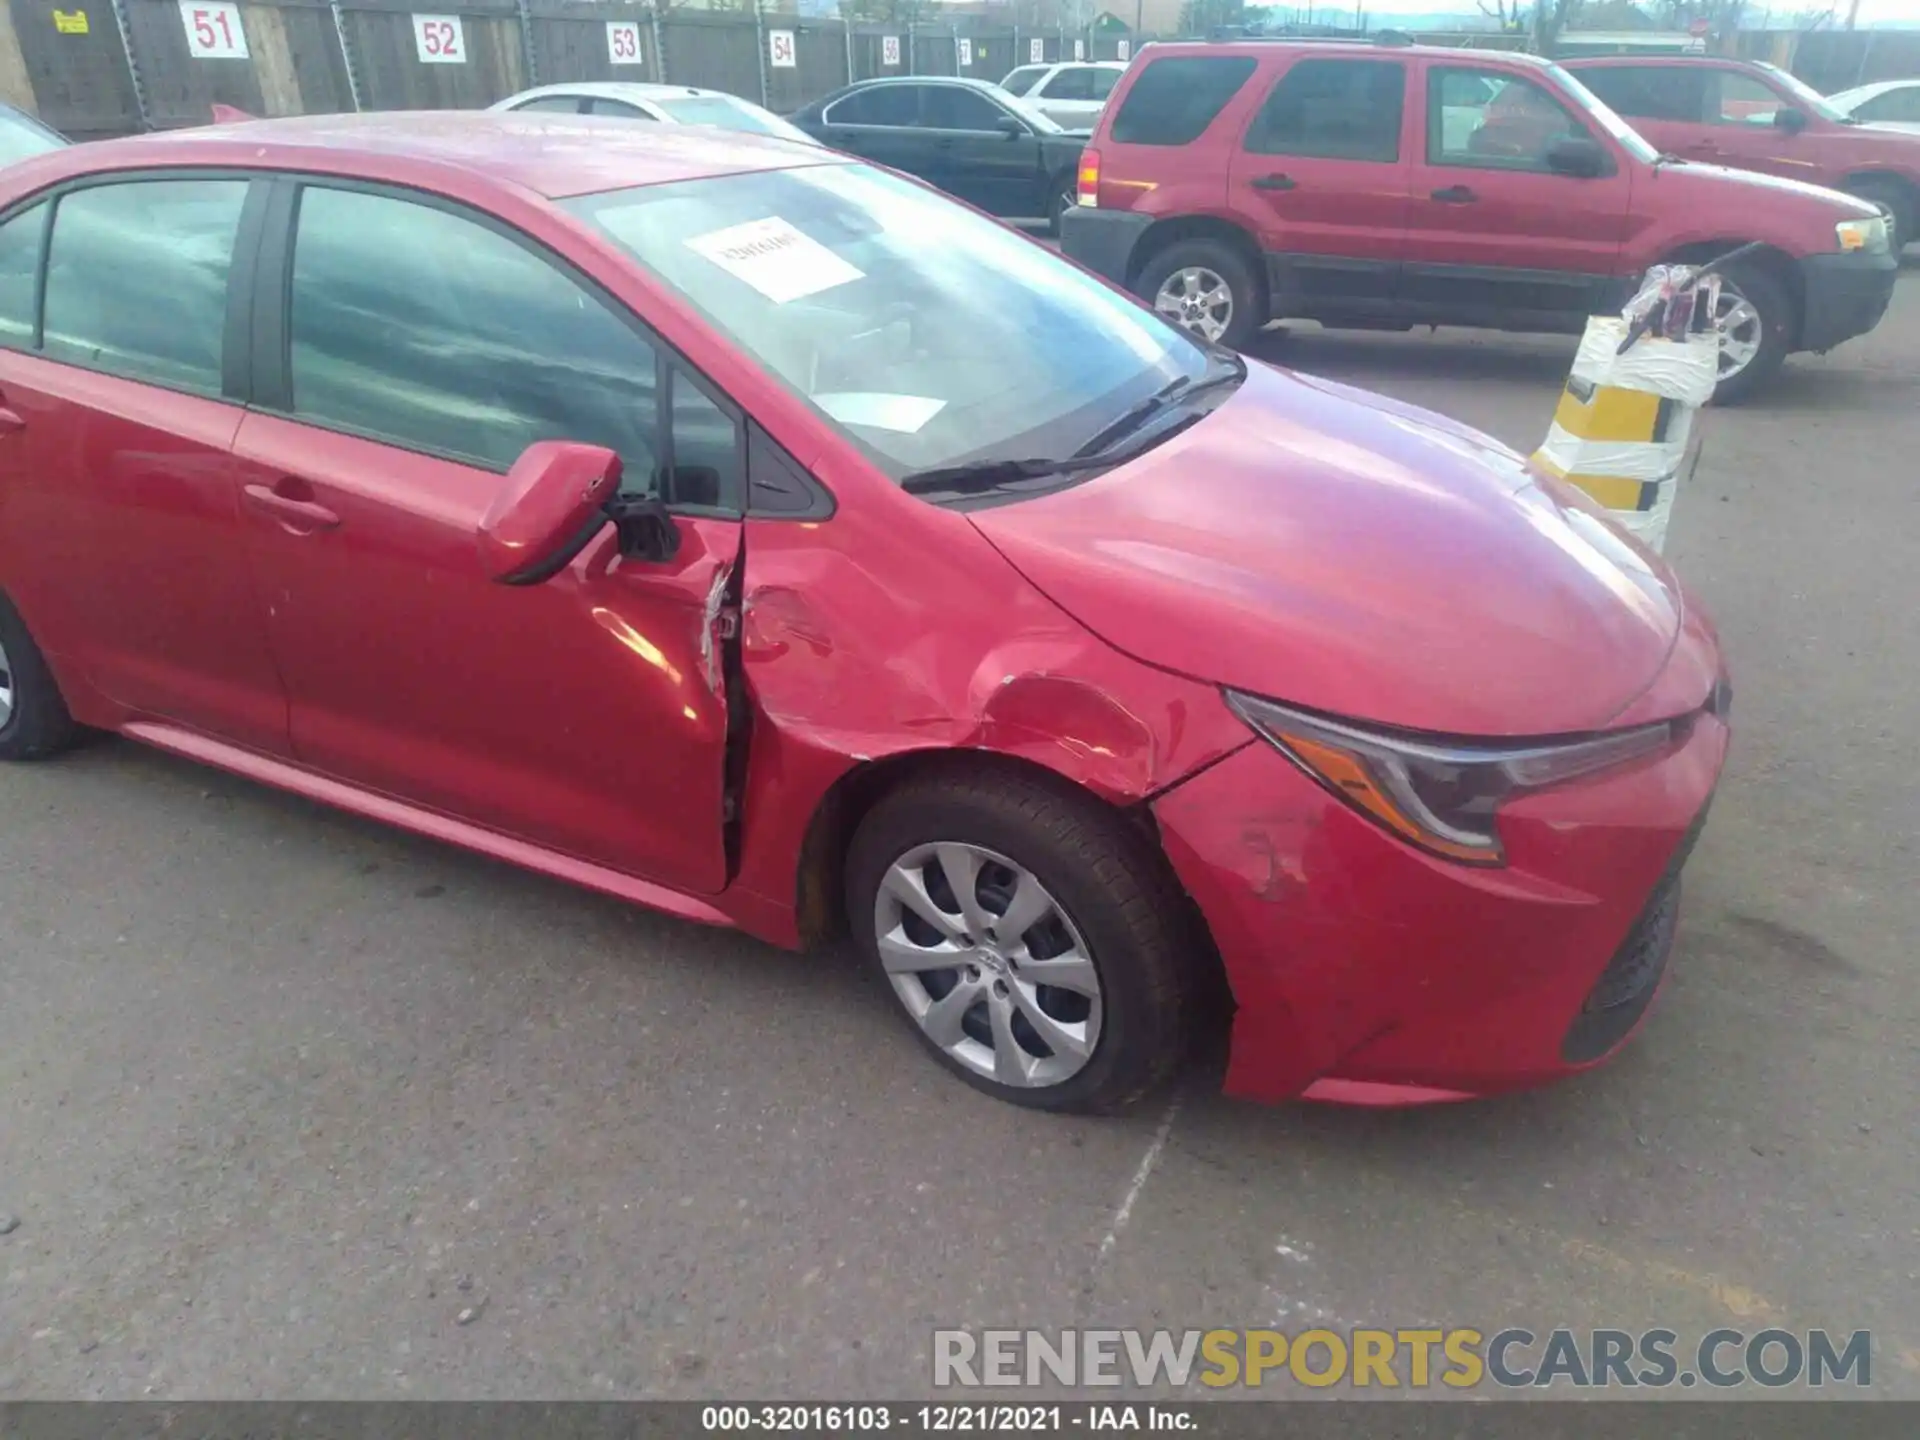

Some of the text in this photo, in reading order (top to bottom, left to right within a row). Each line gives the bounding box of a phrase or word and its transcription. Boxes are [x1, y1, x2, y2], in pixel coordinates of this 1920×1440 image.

[193, 10, 234, 49] 51
[423, 22, 458, 55] 52
[613, 28, 636, 58] 53
[774, 36, 792, 61] 54
